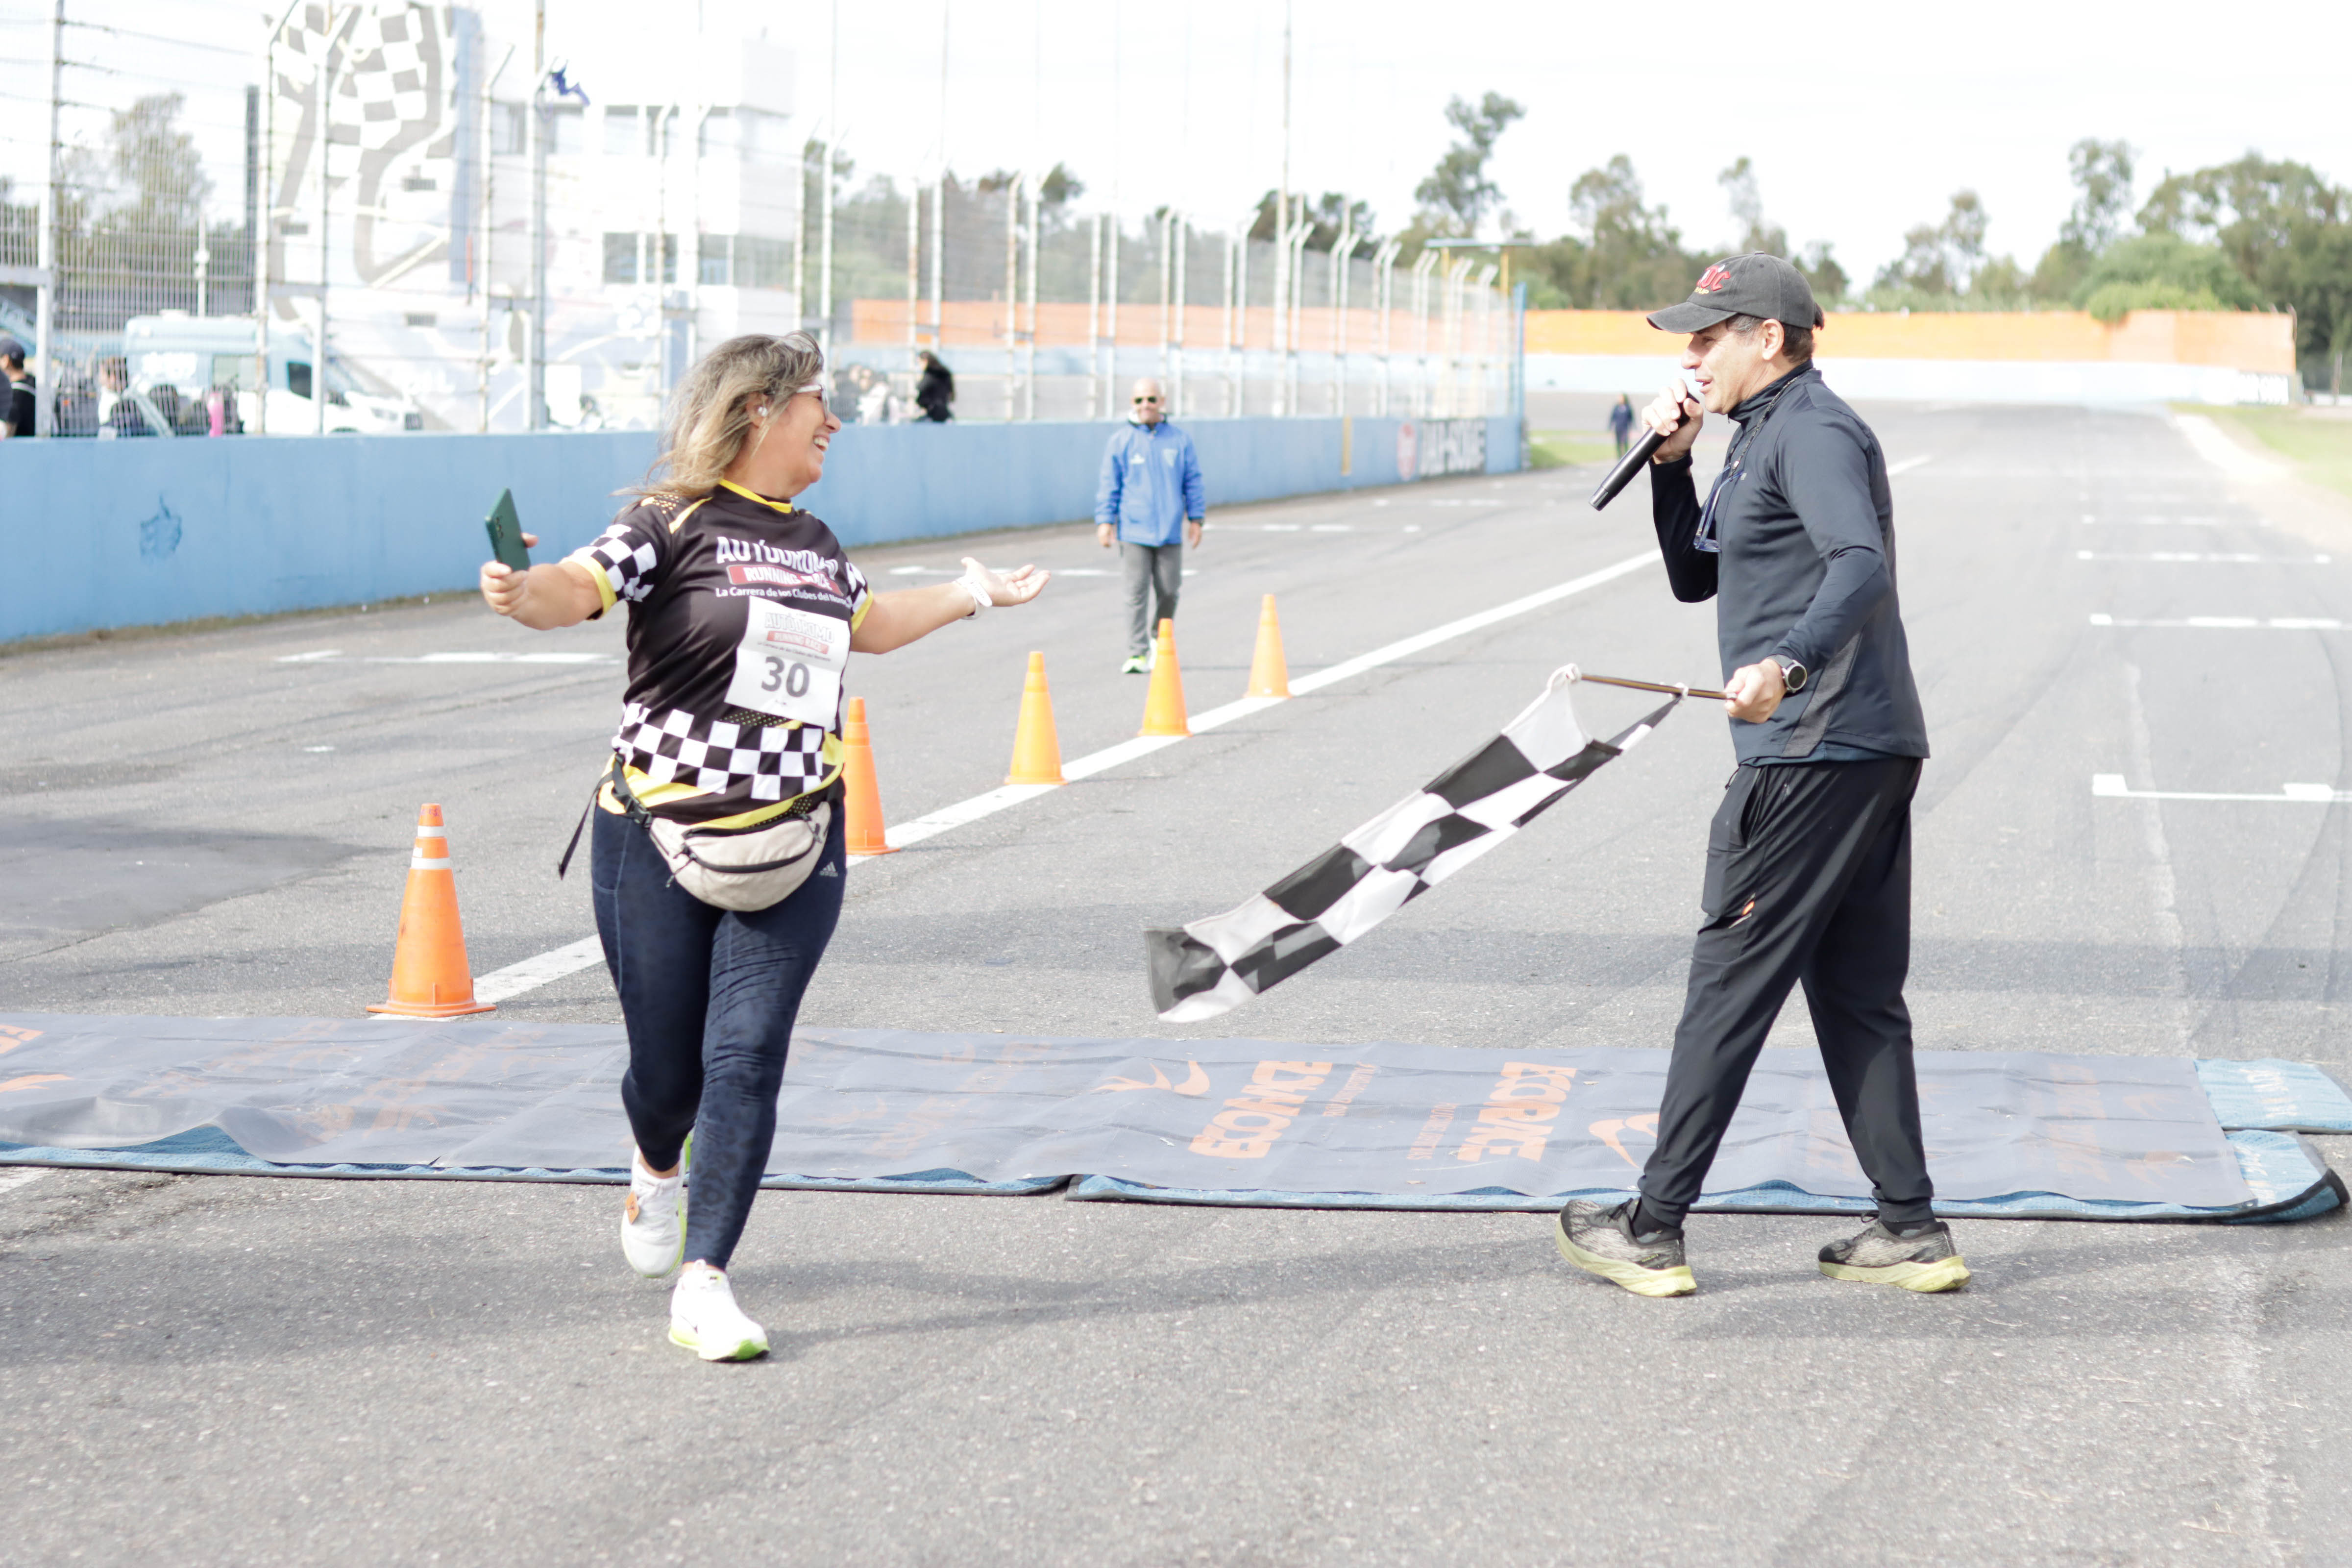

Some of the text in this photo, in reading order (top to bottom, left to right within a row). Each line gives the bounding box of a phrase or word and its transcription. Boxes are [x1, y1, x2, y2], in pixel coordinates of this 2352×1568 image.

[743, 566, 801, 585] RUNNING
[715, 588, 728, 597] La
[729, 587, 765, 597] Carrera
[766, 588, 777, 597] de
[792, 588, 817, 600] Clubes
[817, 592, 830, 602] del
[761, 656, 810, 698] 30
